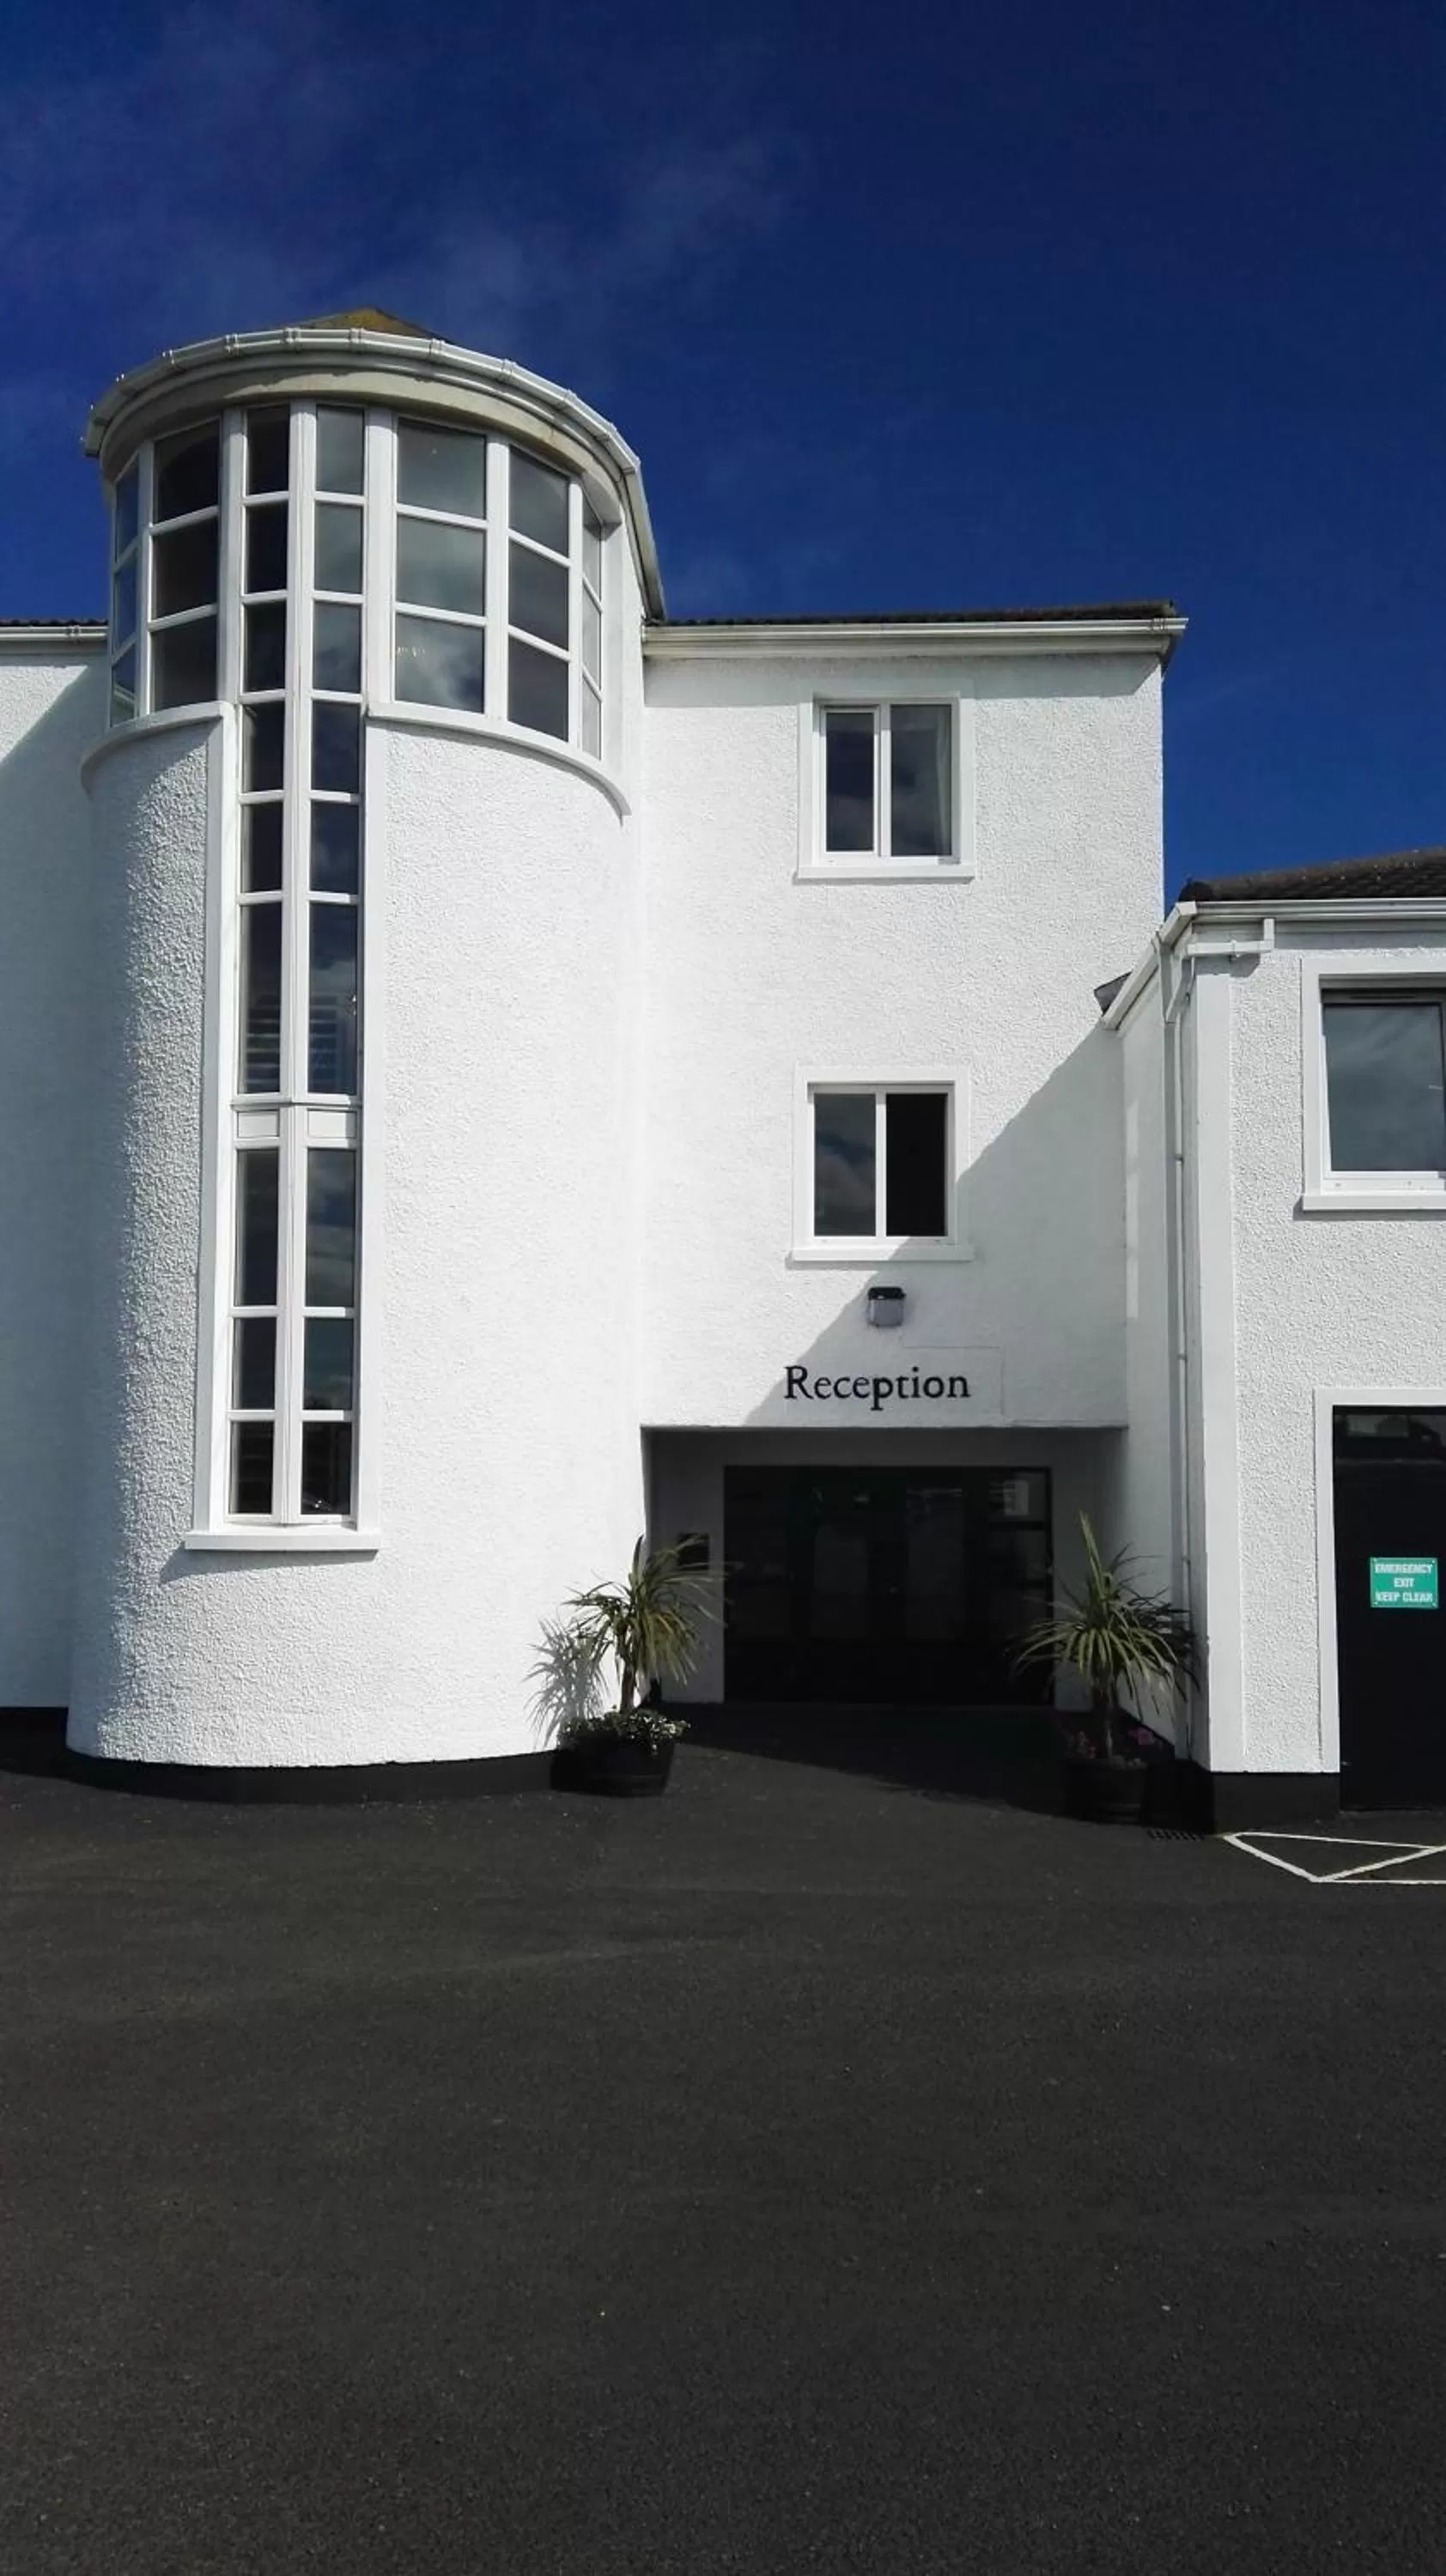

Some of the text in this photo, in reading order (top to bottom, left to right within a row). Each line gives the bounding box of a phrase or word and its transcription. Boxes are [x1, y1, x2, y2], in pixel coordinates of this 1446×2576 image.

[784, 1364, 971, 1411] Reception
[1375, 1564, 1431, 1574] EMERGENCY
[1394, 1577, 1414, 1588] EXIT
[1375, 1591, 1433, 1602] KEEP CLEAR
